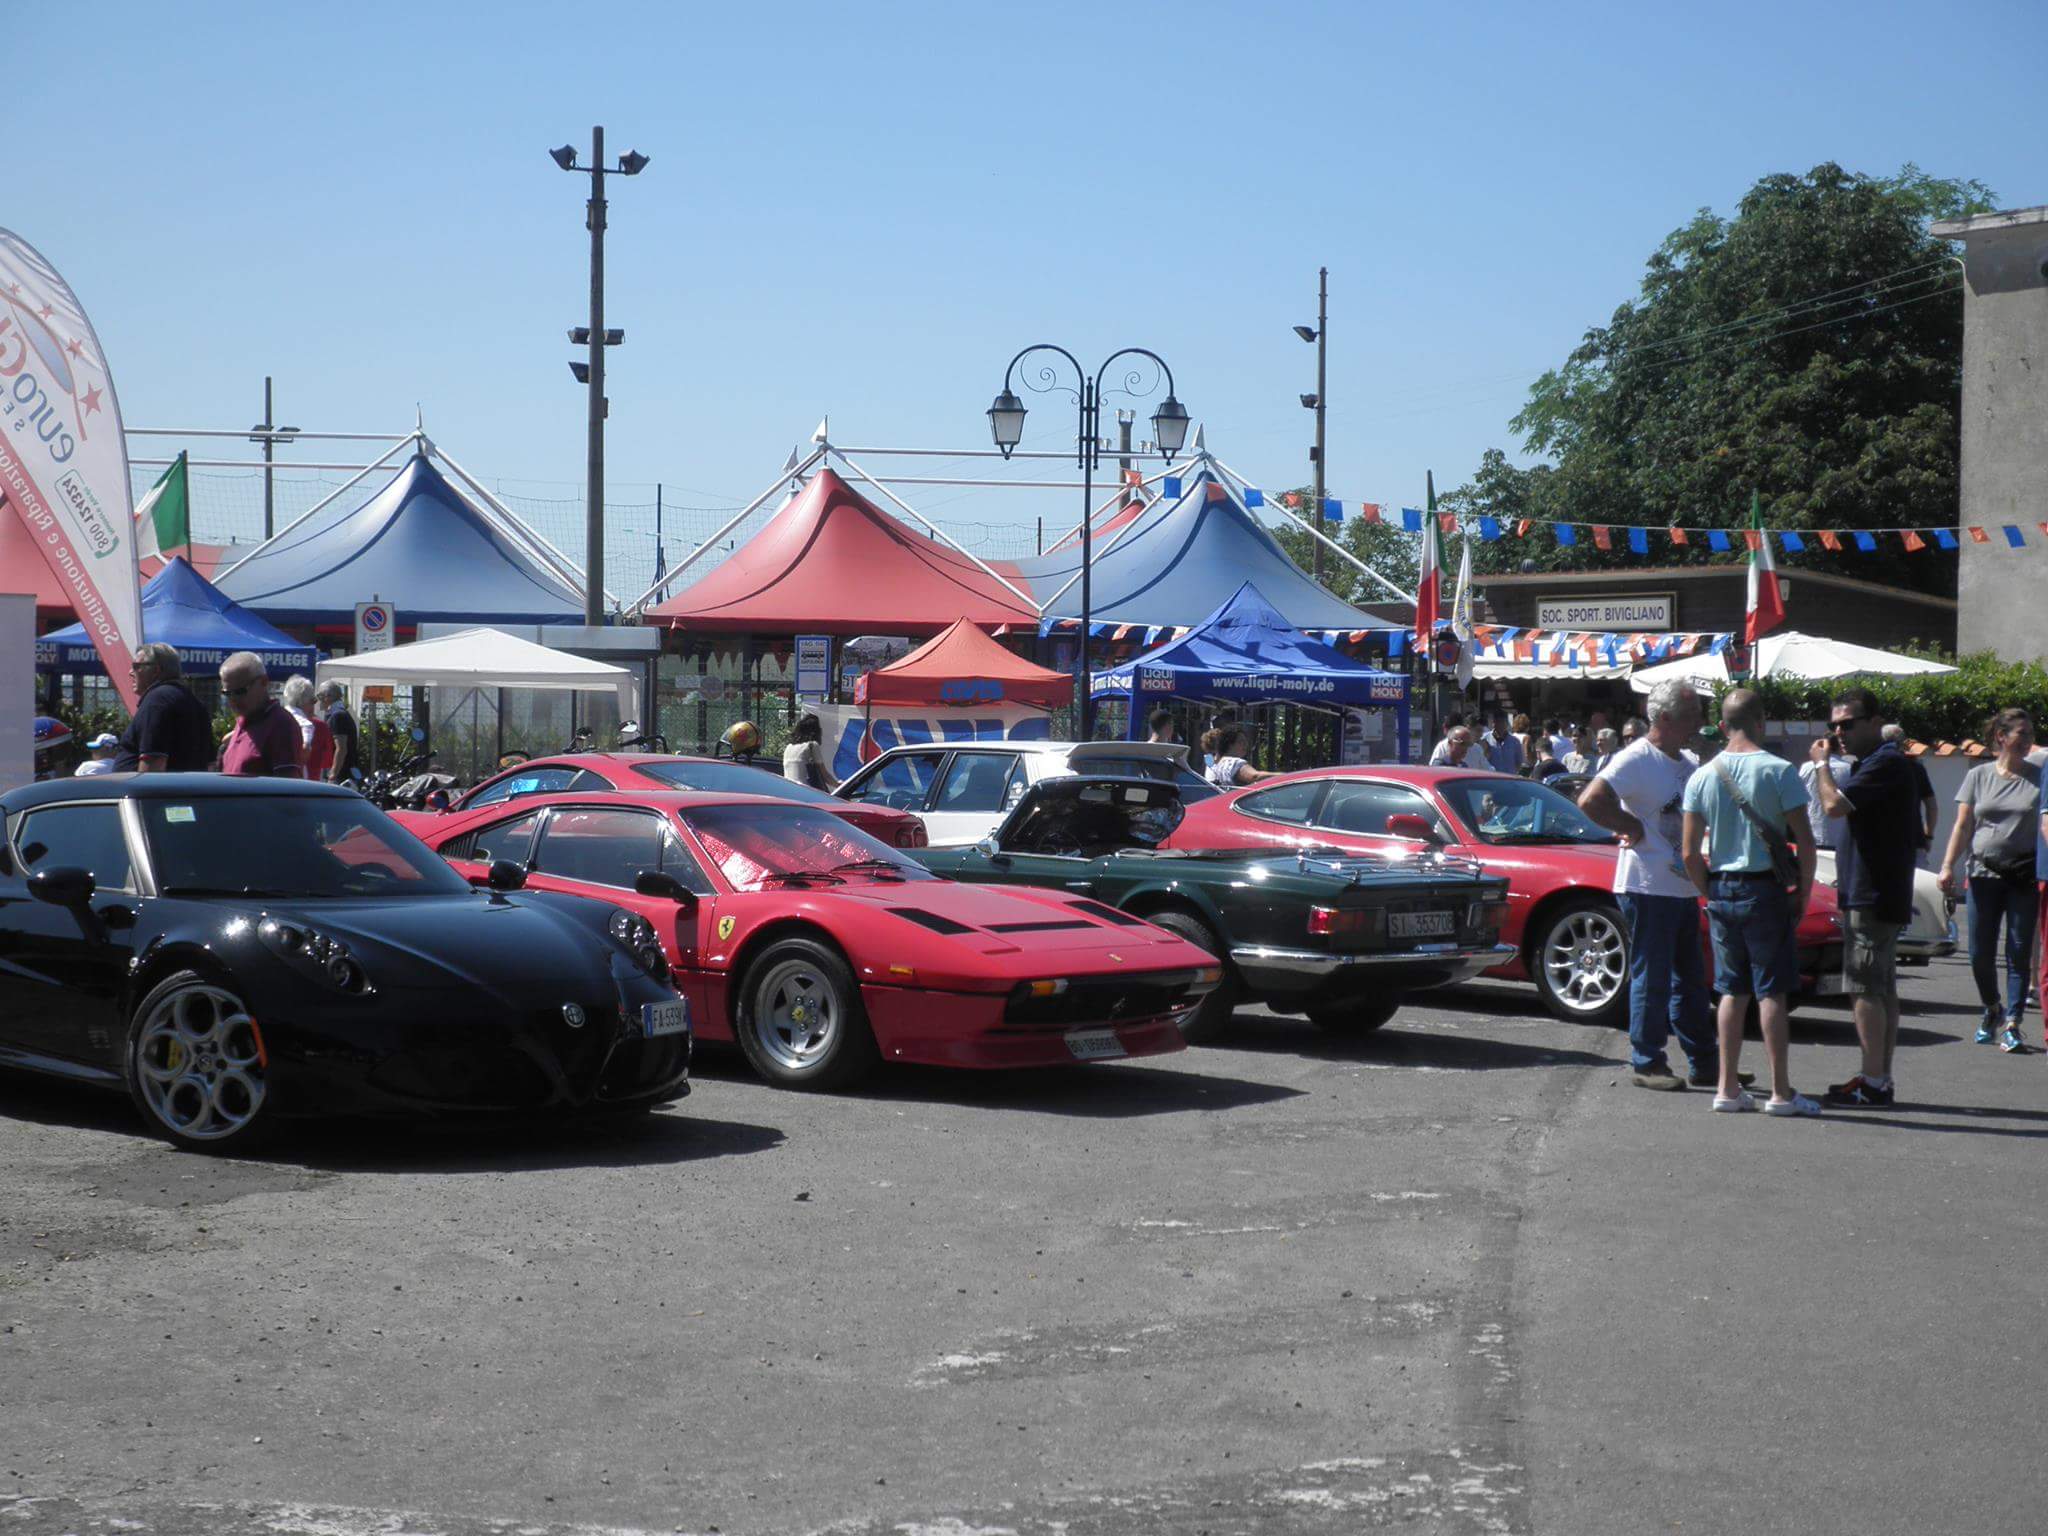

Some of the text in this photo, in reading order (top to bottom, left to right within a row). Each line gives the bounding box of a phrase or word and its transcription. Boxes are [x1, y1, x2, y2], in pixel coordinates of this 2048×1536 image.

[1542, 606, 1665, 623] SOC. SPORT. BIVIGLIANO
[1143, 669, 1173, 679] LIQUI
[1143, 679, 1173, 689] MOLY
[1213, 675, 1335, 693] www.liqui-moly.de
[1372, 677, 1401, 687] LIQUI
[1371, 687, 1402, 698] MOLY
